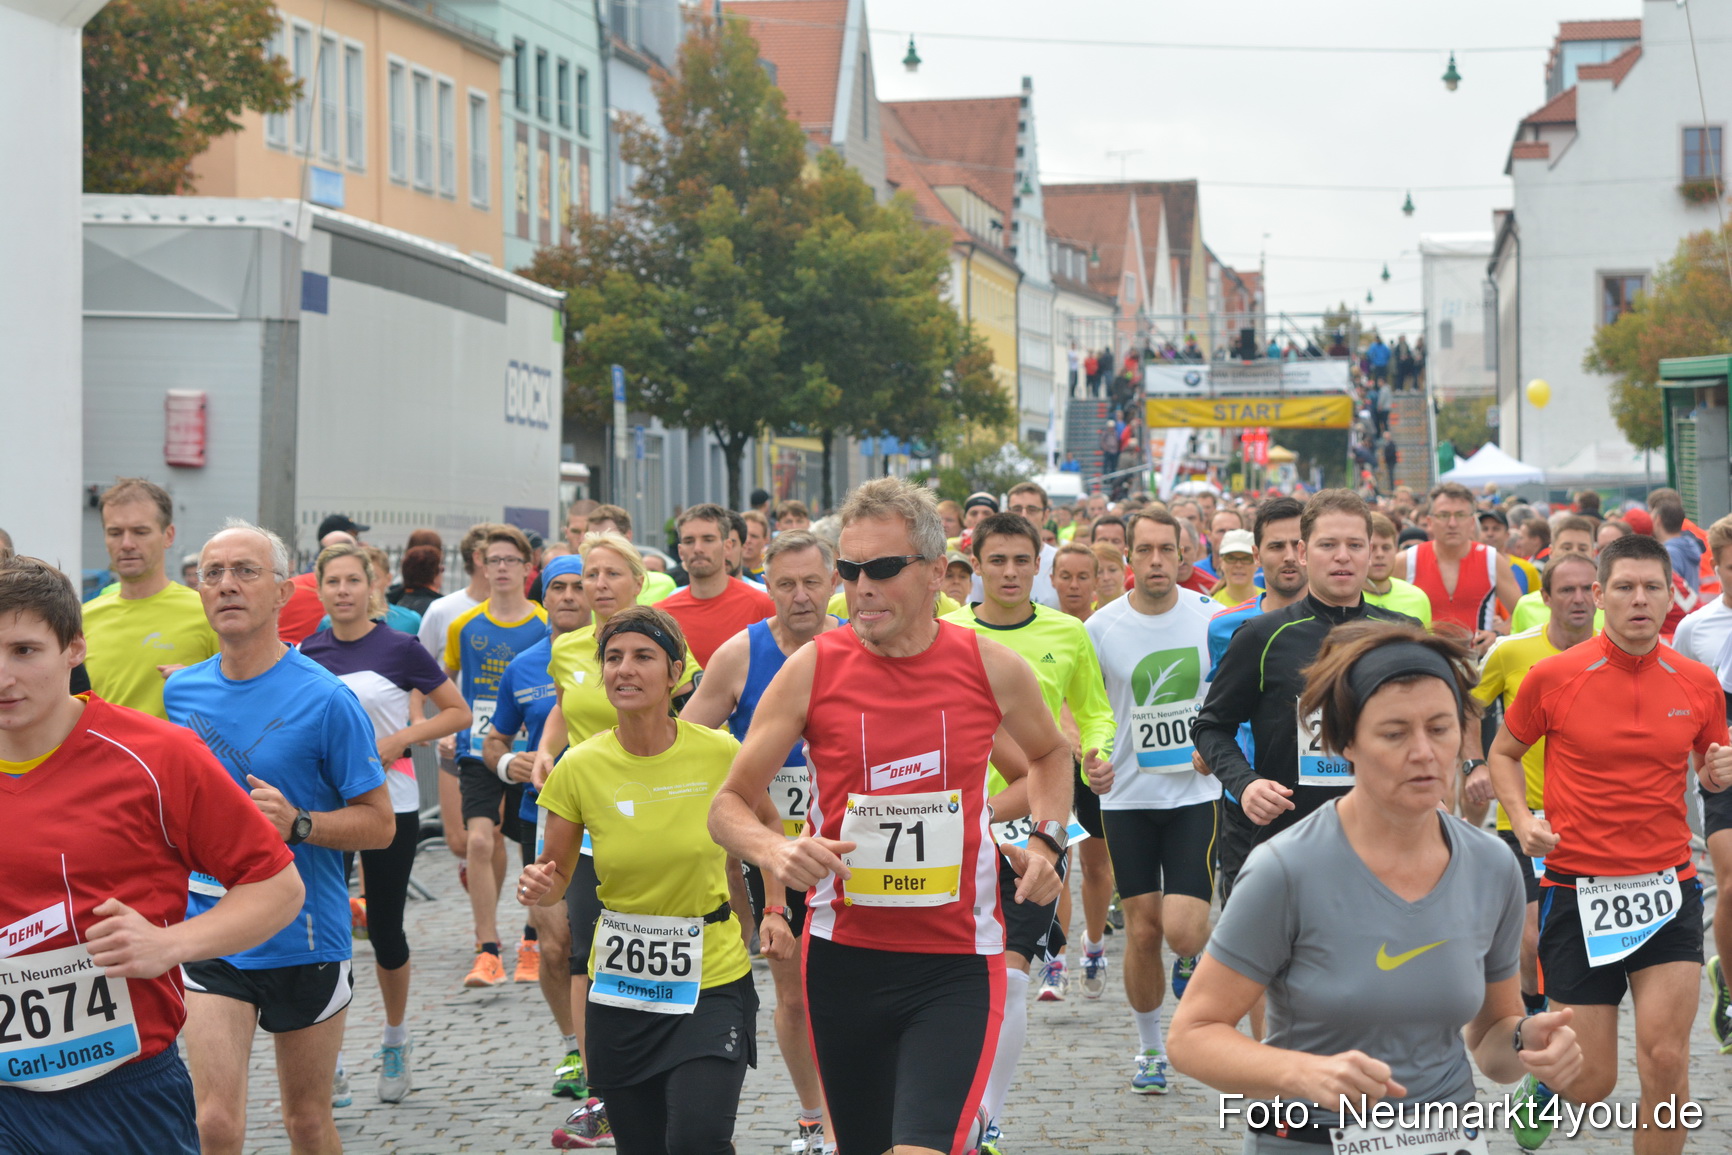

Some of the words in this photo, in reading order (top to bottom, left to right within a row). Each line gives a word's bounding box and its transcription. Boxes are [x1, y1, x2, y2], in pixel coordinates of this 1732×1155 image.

[504, 360, 551, 430] BOCK
[1213, 403, 1283, 421] START
[1157, 706, 1192, 718] Neumarkt
[889, 762, 922, 779] DEHN
[886, 803, 943, 816] Neumarkt
[879, 821, 925, 862] 71
[883, 874, 926, 891] Peter
[1579, 884, 1612, 895] PARTL
[1614, 878, 1660, 890] Neumarkt
[1590, 889, 1674, 931] 2830
[9, 920, 44, 946] DEHN
[602, 918, 632, 932] PARTL
[633, 924, 684, 936] Neumarkt
[605, 935, 692, 977] 2655
[21, 957, 94, 983] Neumarkt
[617, 980, 673, 999] Cornelia
[0, 975, 117, 1044] 2674
[8, 1041, 115, 1077] Carl-Jonas
[1337, 1136, 1393, 1155] PARTL
[1395, 1128, 1461, 1147] Neumarkt
